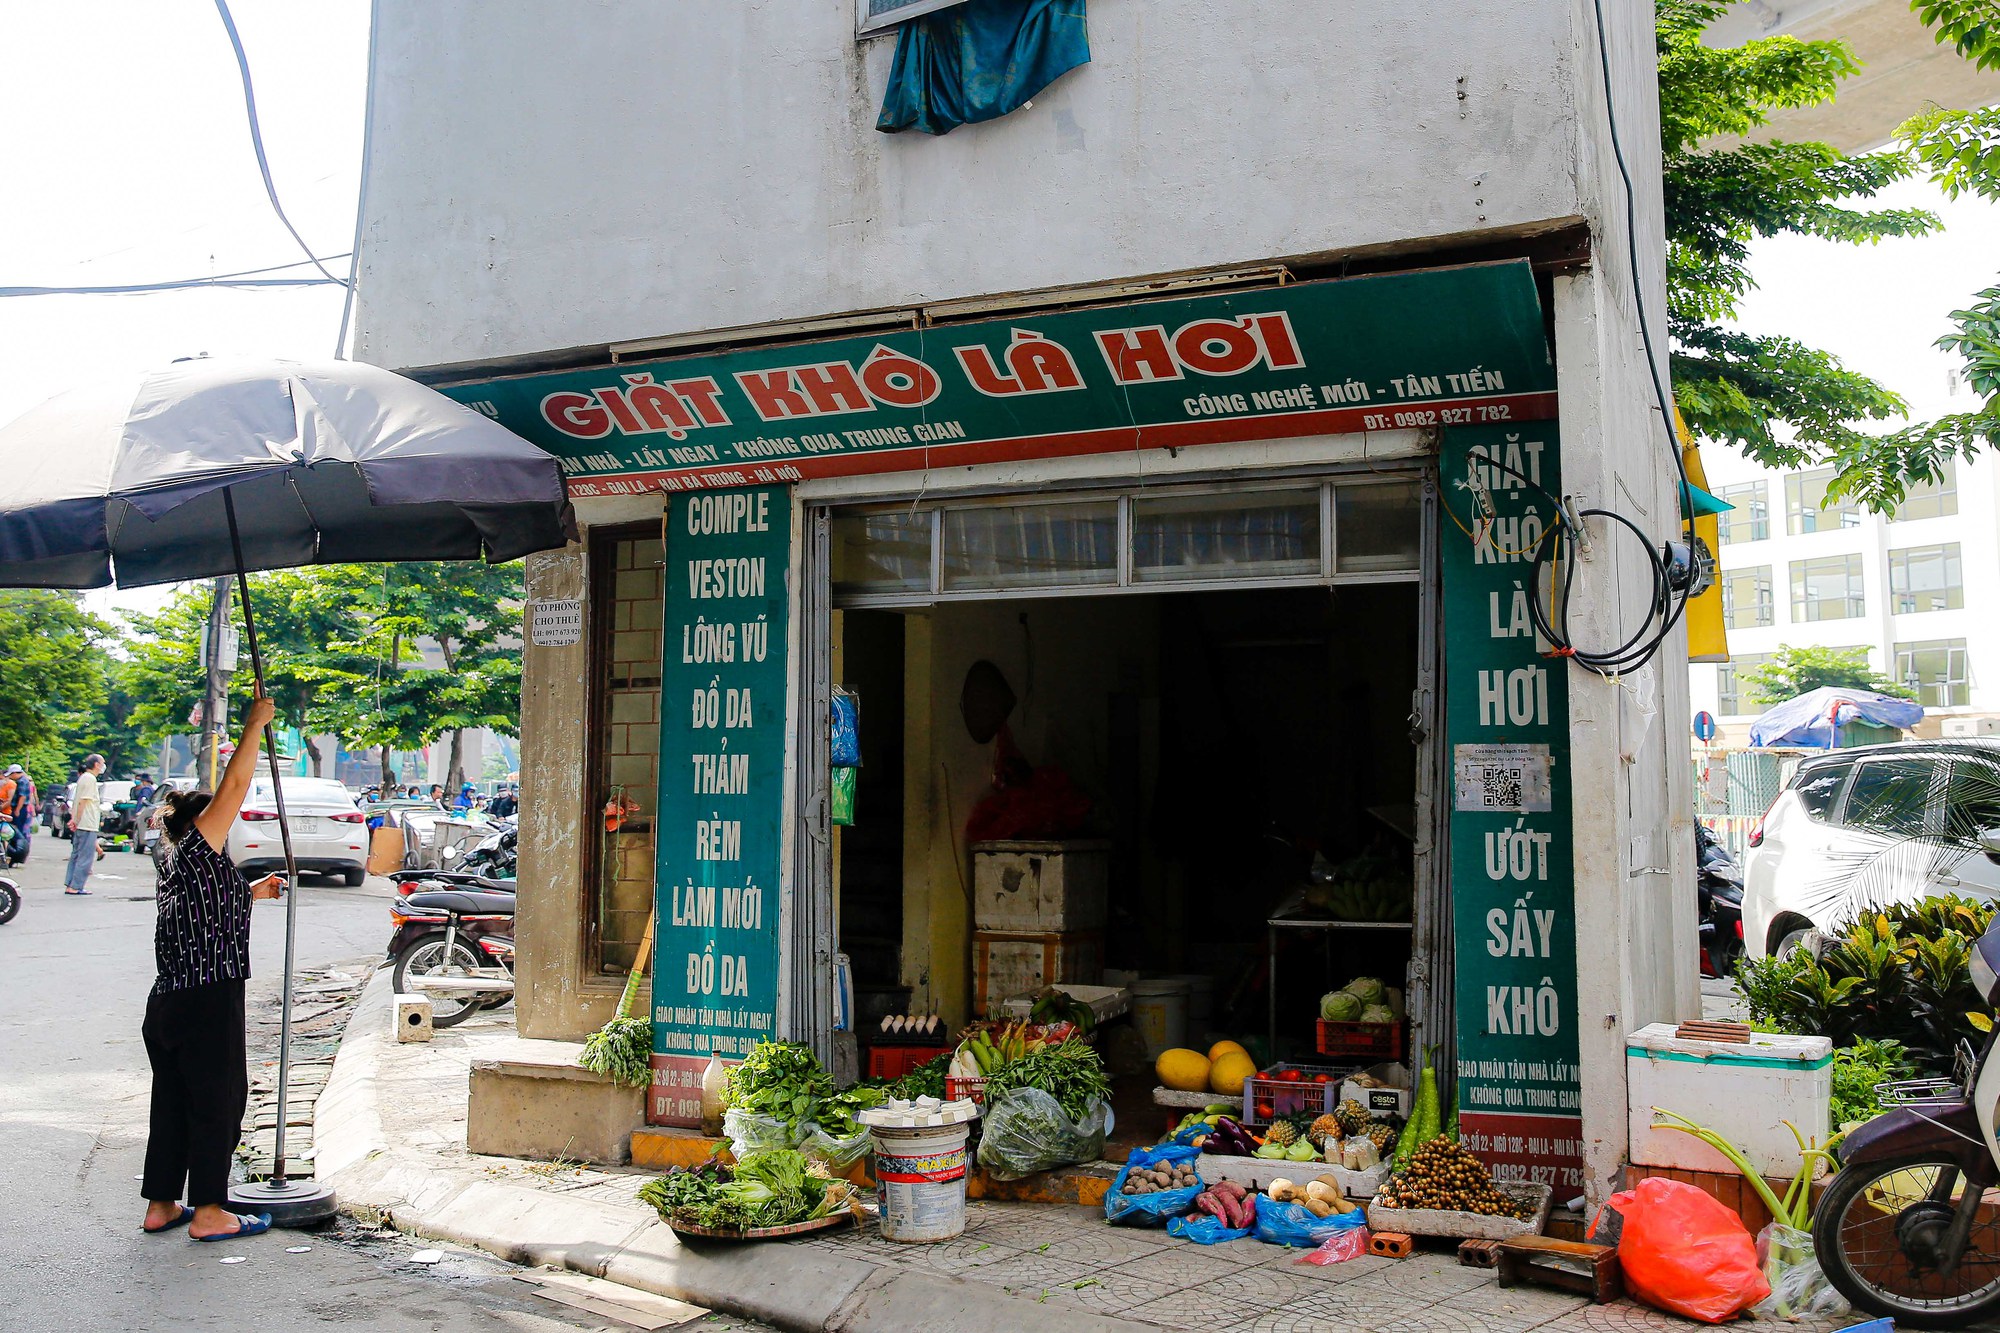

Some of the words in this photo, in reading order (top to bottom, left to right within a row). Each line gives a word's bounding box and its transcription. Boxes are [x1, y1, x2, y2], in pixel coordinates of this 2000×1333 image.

[540, 371, 733, 441] GIẶT
[733, 343, 942, 422] KHÔ
[953, 328, 1087, 398] LÀ
[1092, 310, 1306, 386] HƠI
[1183, 392, 1250, 417] CÔNG
[1250, 384, 1318, 414] NGHỆ
[1324, 376, 1370, 405] MỚI
[1389, 373, 1443, 399] TÂN
[1448, 365, 1504, 395] TIẾN
[1363, 412, 1392, 431] ĐT:
[1394, 409, 1437, 428] 0982
[1440, 407, 1474, 425] 827
[1477, 404, 1512, 422] 782
[556, 455, 586, 476] ẬN
[582, 450, 625, 472] NHÀ
[632, 445, 669, 468] LẤY
[668, 444, 719, 464] NGAY
[731, 436, 802, 458] KHÔNG
[800, 434, 844, 453] QUA
[842, 426, 912, 448] TRUNG
[912, 421, 966, 442] GIAN
[1466, 433, 1545, 500] GIẶT
[628, 479, 647, 493] LA
[657, 475, 685, 492] HAI
[684, 473, 703, 489] BÀ
[753, 466, 777, 482] HÀ
[776, 464, 803, 482] NỘI
[687, 492, 769, 536] COMPLE
[1473, 505, 1543, 565] KHÔ
[688, 557, 765, 599] VESTON
[535, 616, 554, 626] CHO
[555, 613, 580, 625] THUÊ
[1489, 580, 1533, 638] LÀ
[682, 615, 735, 664] LÔNG
[741, 613, 768, 663] VŨ
[692, 674, 720, 729] ĐỒ
[725, 688, 753, 729] DA
[1478, 664, 1549, 726] HƠI
[692, 736, 749, 794] THẢM
[696, 811, 741, 861] RÈM
[1484, 817, 1552, 881] ƯỚT
[672, 877, 716, 928] LÀM
[721, 875, 762, 930] MỚI
[1486, 891, 1555, 958] SẤY
[686, 939, 716, 996] ĐỒ
[720, 954, 749, 997] DA
[655, 1006, 673, 1023] GIAO
[675, 1004, 696, 1028] NHẬN
[698, 1005, 714, 1030] TẬN
[715, 1006, 732, 1028] NHÀ
[733, 1005, 749, 1029] LẤY
[749, 1012, 772, 1031] NGAY
[1487, 976, 1559, 1037] KHÔ
[666, 1029, 693, 1050] KHÔNG
[694, 1034, 709, 1053] QUA
[712, 1035, 737, 1054] TRUNG
[1470, 1083, 1502, 1105] KHÔNG
[1504, 1088, 1523, 1107] QUA
[1525, 1089, 1557, 1108] TRUNG
[1479, 1058, 1505, 1082] NHẬN
[1507, 1058, 1526, 1083] TẬN
[1528, 1059, 1548, 1081] NHÀ
[1550, 1058, 1568, 1082] LẤY
[679, 1098, 704, 1120] 098
[1480, 1135, 1489, 1152] 22
[1554, 1138, 1566, 1156] HAI
[1492, 1163, 1527, 1182] 0982
[1531, 1164, 1557, 1185] 827
